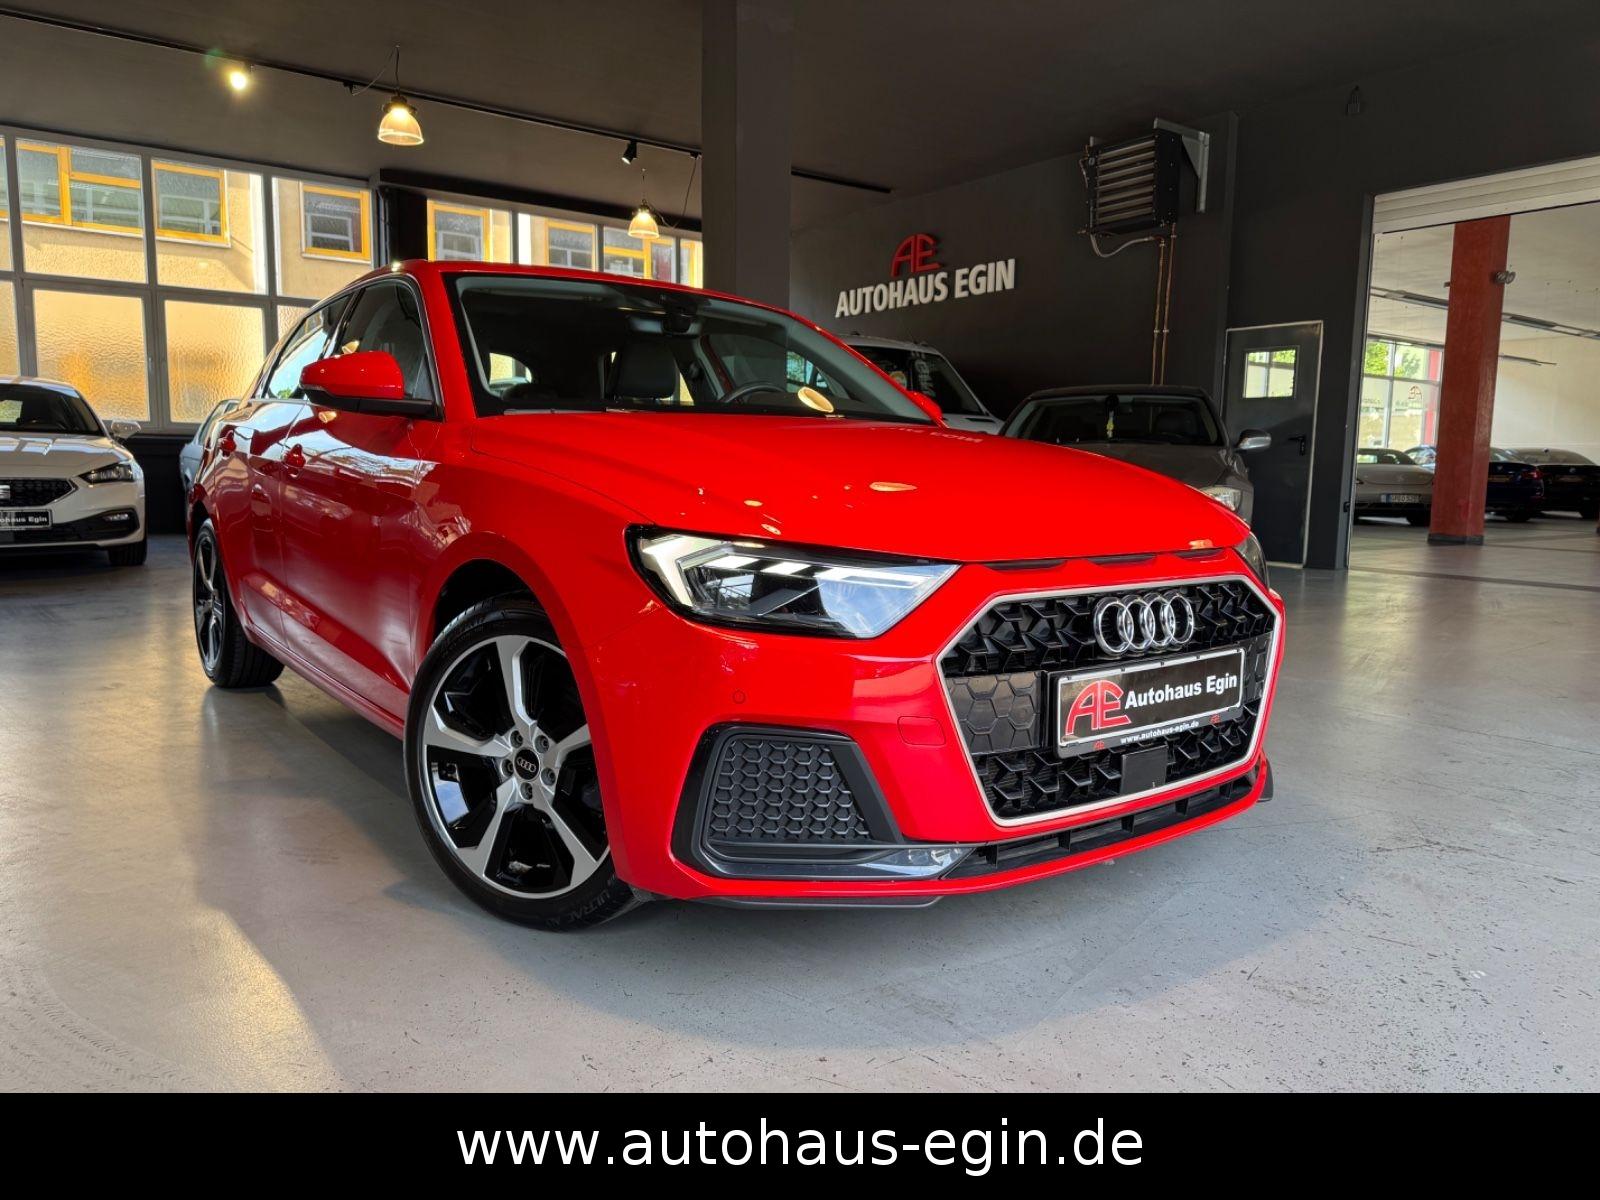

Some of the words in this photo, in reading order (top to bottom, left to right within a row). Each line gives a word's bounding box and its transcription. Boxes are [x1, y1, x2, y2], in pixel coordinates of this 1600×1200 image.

[891, 233, 942, 278] AE
[835, 271, 949, 318] AUTOHAUS
[954, 258, 1016, 298] EGIN
[1065, 680, 1132, 735] AE
[1124, 681, 1202, 710] Autohaus
[1206, 672, 1238, 695] Egin
[1120, 720, 1200, 744] www.autohaus-egin.de
